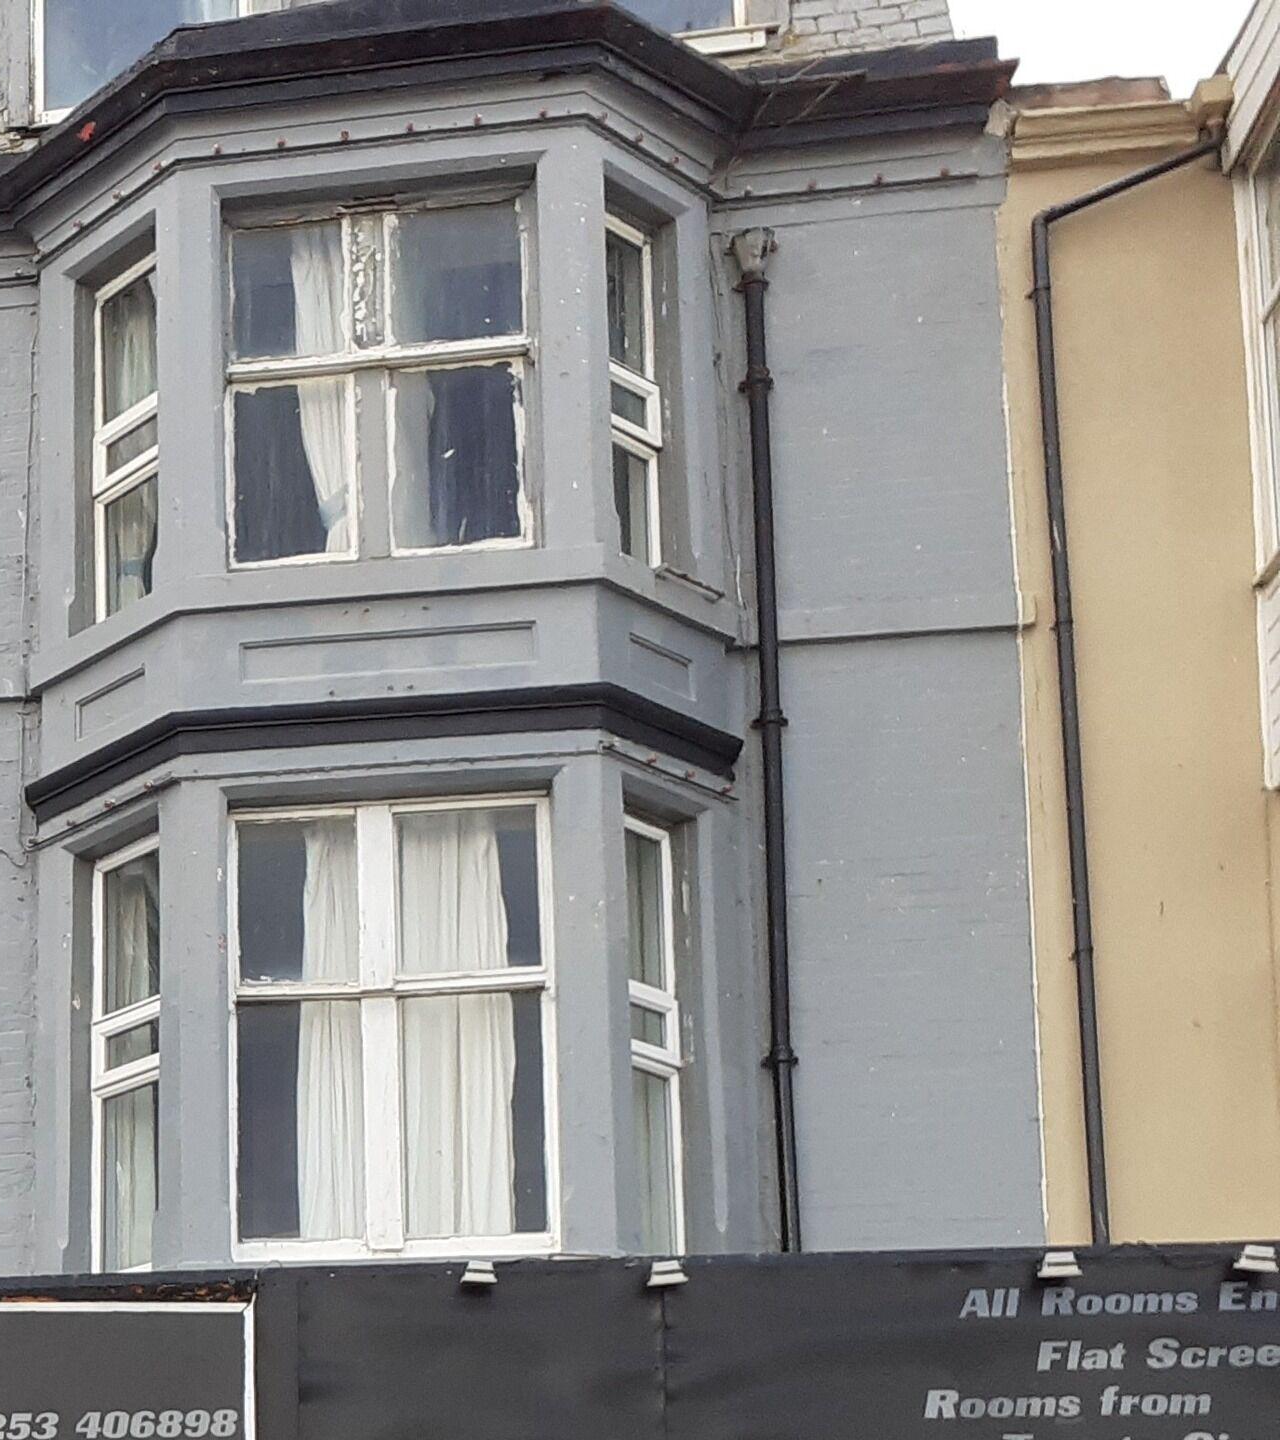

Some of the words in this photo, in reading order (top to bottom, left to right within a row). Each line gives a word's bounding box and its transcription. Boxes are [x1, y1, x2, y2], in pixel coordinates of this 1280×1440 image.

[959, 1288, 1020, 1319] All
[1041, 1286, 1198, 1316] Rooms
[1037, 1340, 1126, 1371] Flat
[924, 1389, 1081, 1419] Rooms
[1100, 1385, 1211, 1416] from
[76, 1409, 237, 1439] 406898
